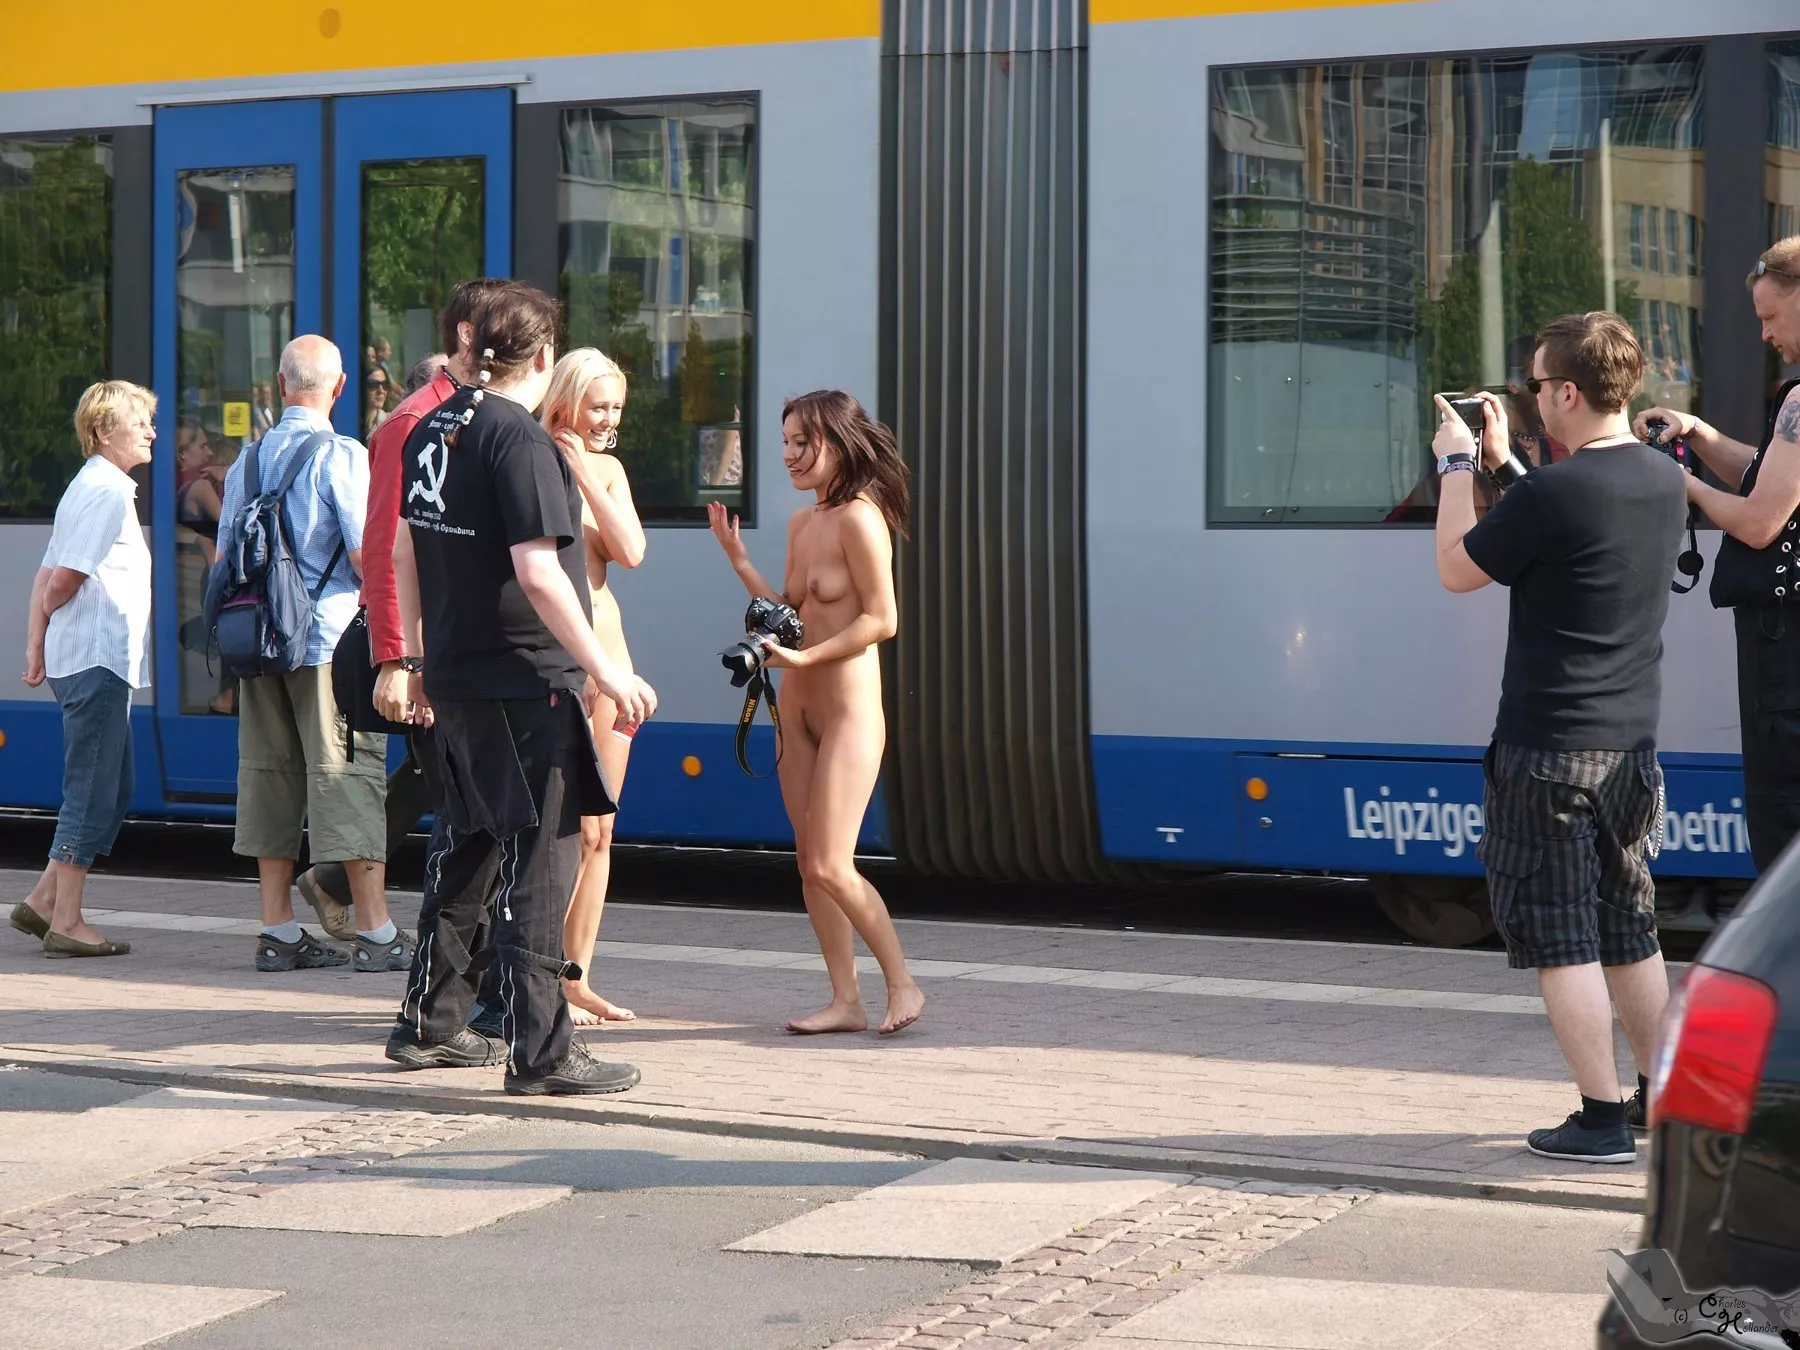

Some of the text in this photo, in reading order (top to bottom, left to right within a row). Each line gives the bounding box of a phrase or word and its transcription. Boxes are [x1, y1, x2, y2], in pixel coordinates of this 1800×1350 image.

[743, 698, 757, 723] Nikon
[1343, 785, 1751, 858] Leipzige betri
